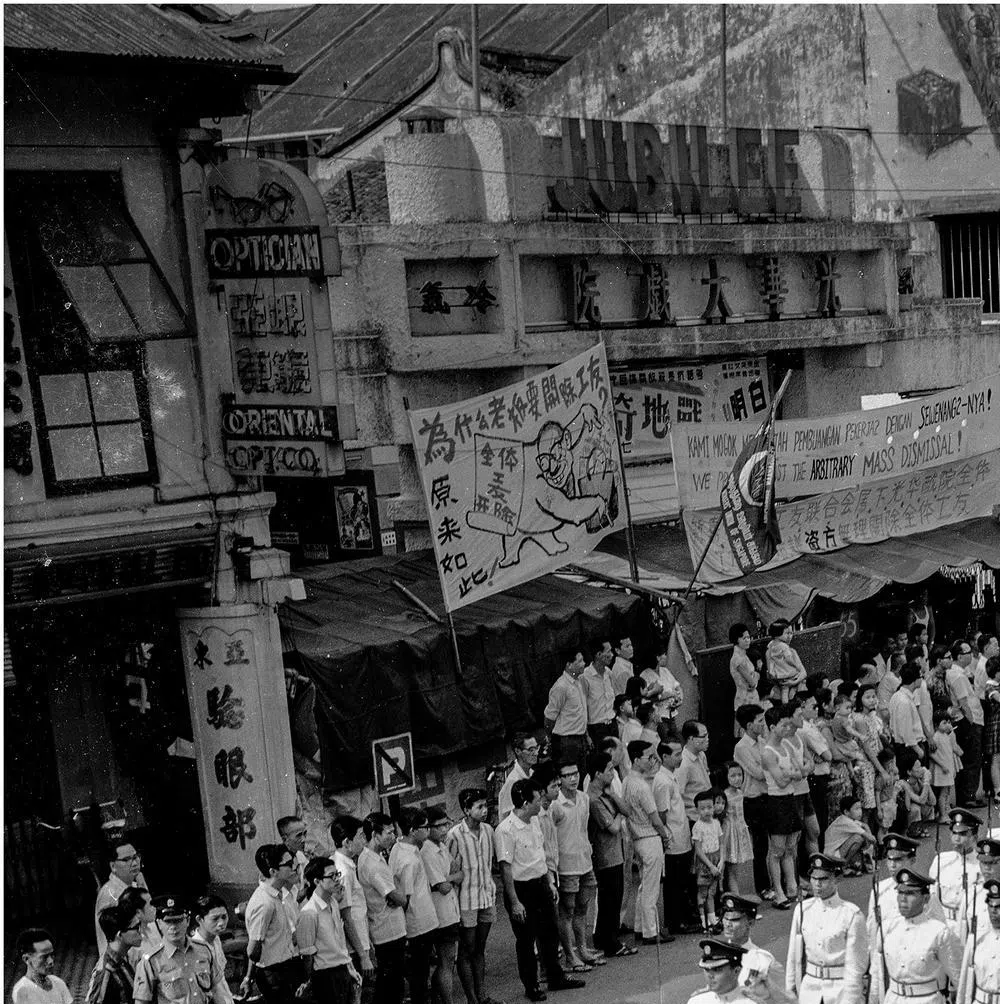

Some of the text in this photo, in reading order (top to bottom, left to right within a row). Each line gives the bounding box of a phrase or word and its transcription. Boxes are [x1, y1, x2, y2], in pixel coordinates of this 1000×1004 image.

[547, 116, 800, 214] JUBILEE
[211, 234, 321, 272] OPTICIAN
[223, 409, 333, 438] ORIENTAL
[687, 435, 710, 459] KAMI
[712, 432, 738, 458] MOGOK
[794, 425, 842, 452] PEMBUANGAN
[885, 413, 913, 436] DENGAN
[692, 472, 711, 492] WE
[809, 454, 857, 481] ARBITRARY
[862, 445, 896, 477] MASS
[206, 684, 257, 851] 驗眼部
